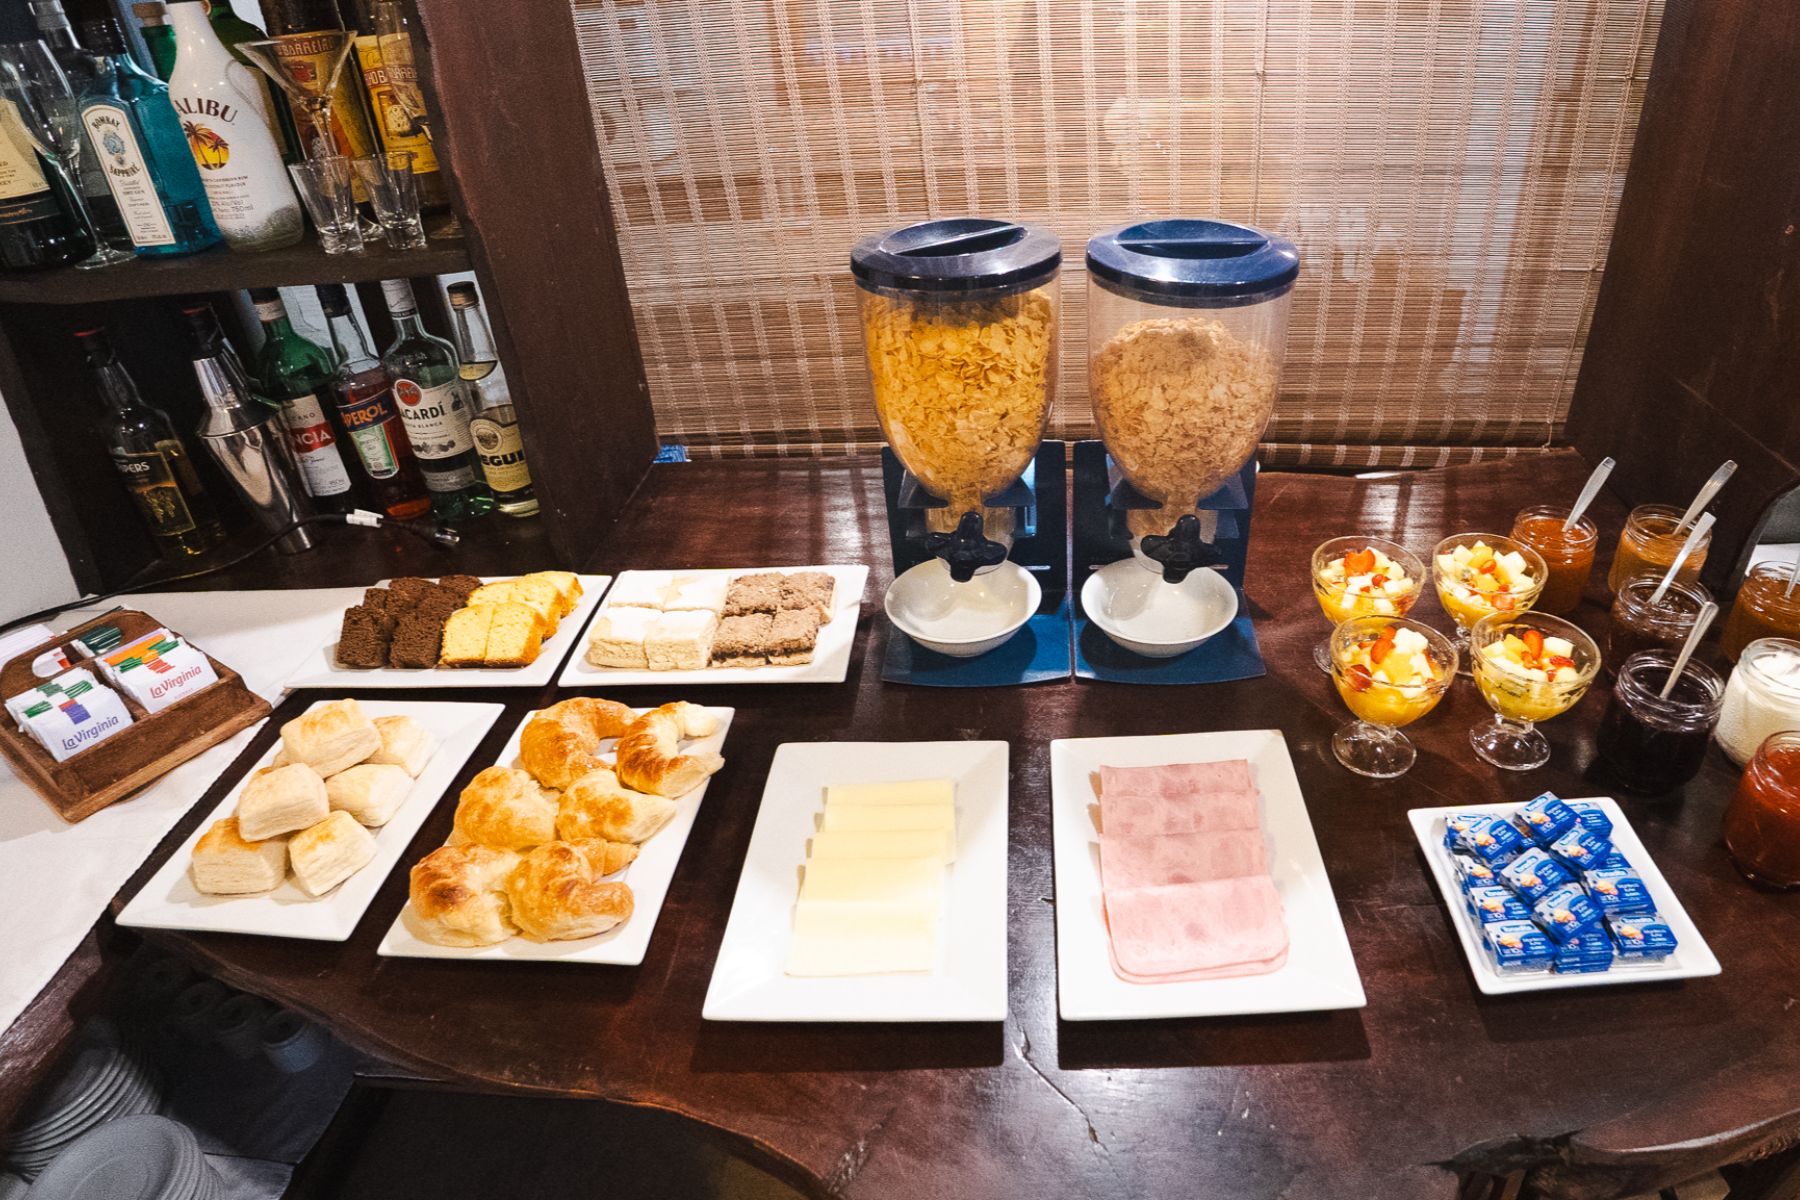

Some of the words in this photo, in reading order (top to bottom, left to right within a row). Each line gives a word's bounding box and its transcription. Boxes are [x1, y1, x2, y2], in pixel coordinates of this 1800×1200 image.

[174, 97, 238, 123] ALIBU
[92, 115, 121, 131] BOMBAY
[400, 401, 446, 420] ACARDÍ
[294, 429, 332, 446] NCIA
[480, 449, 526, 467] EGUI
